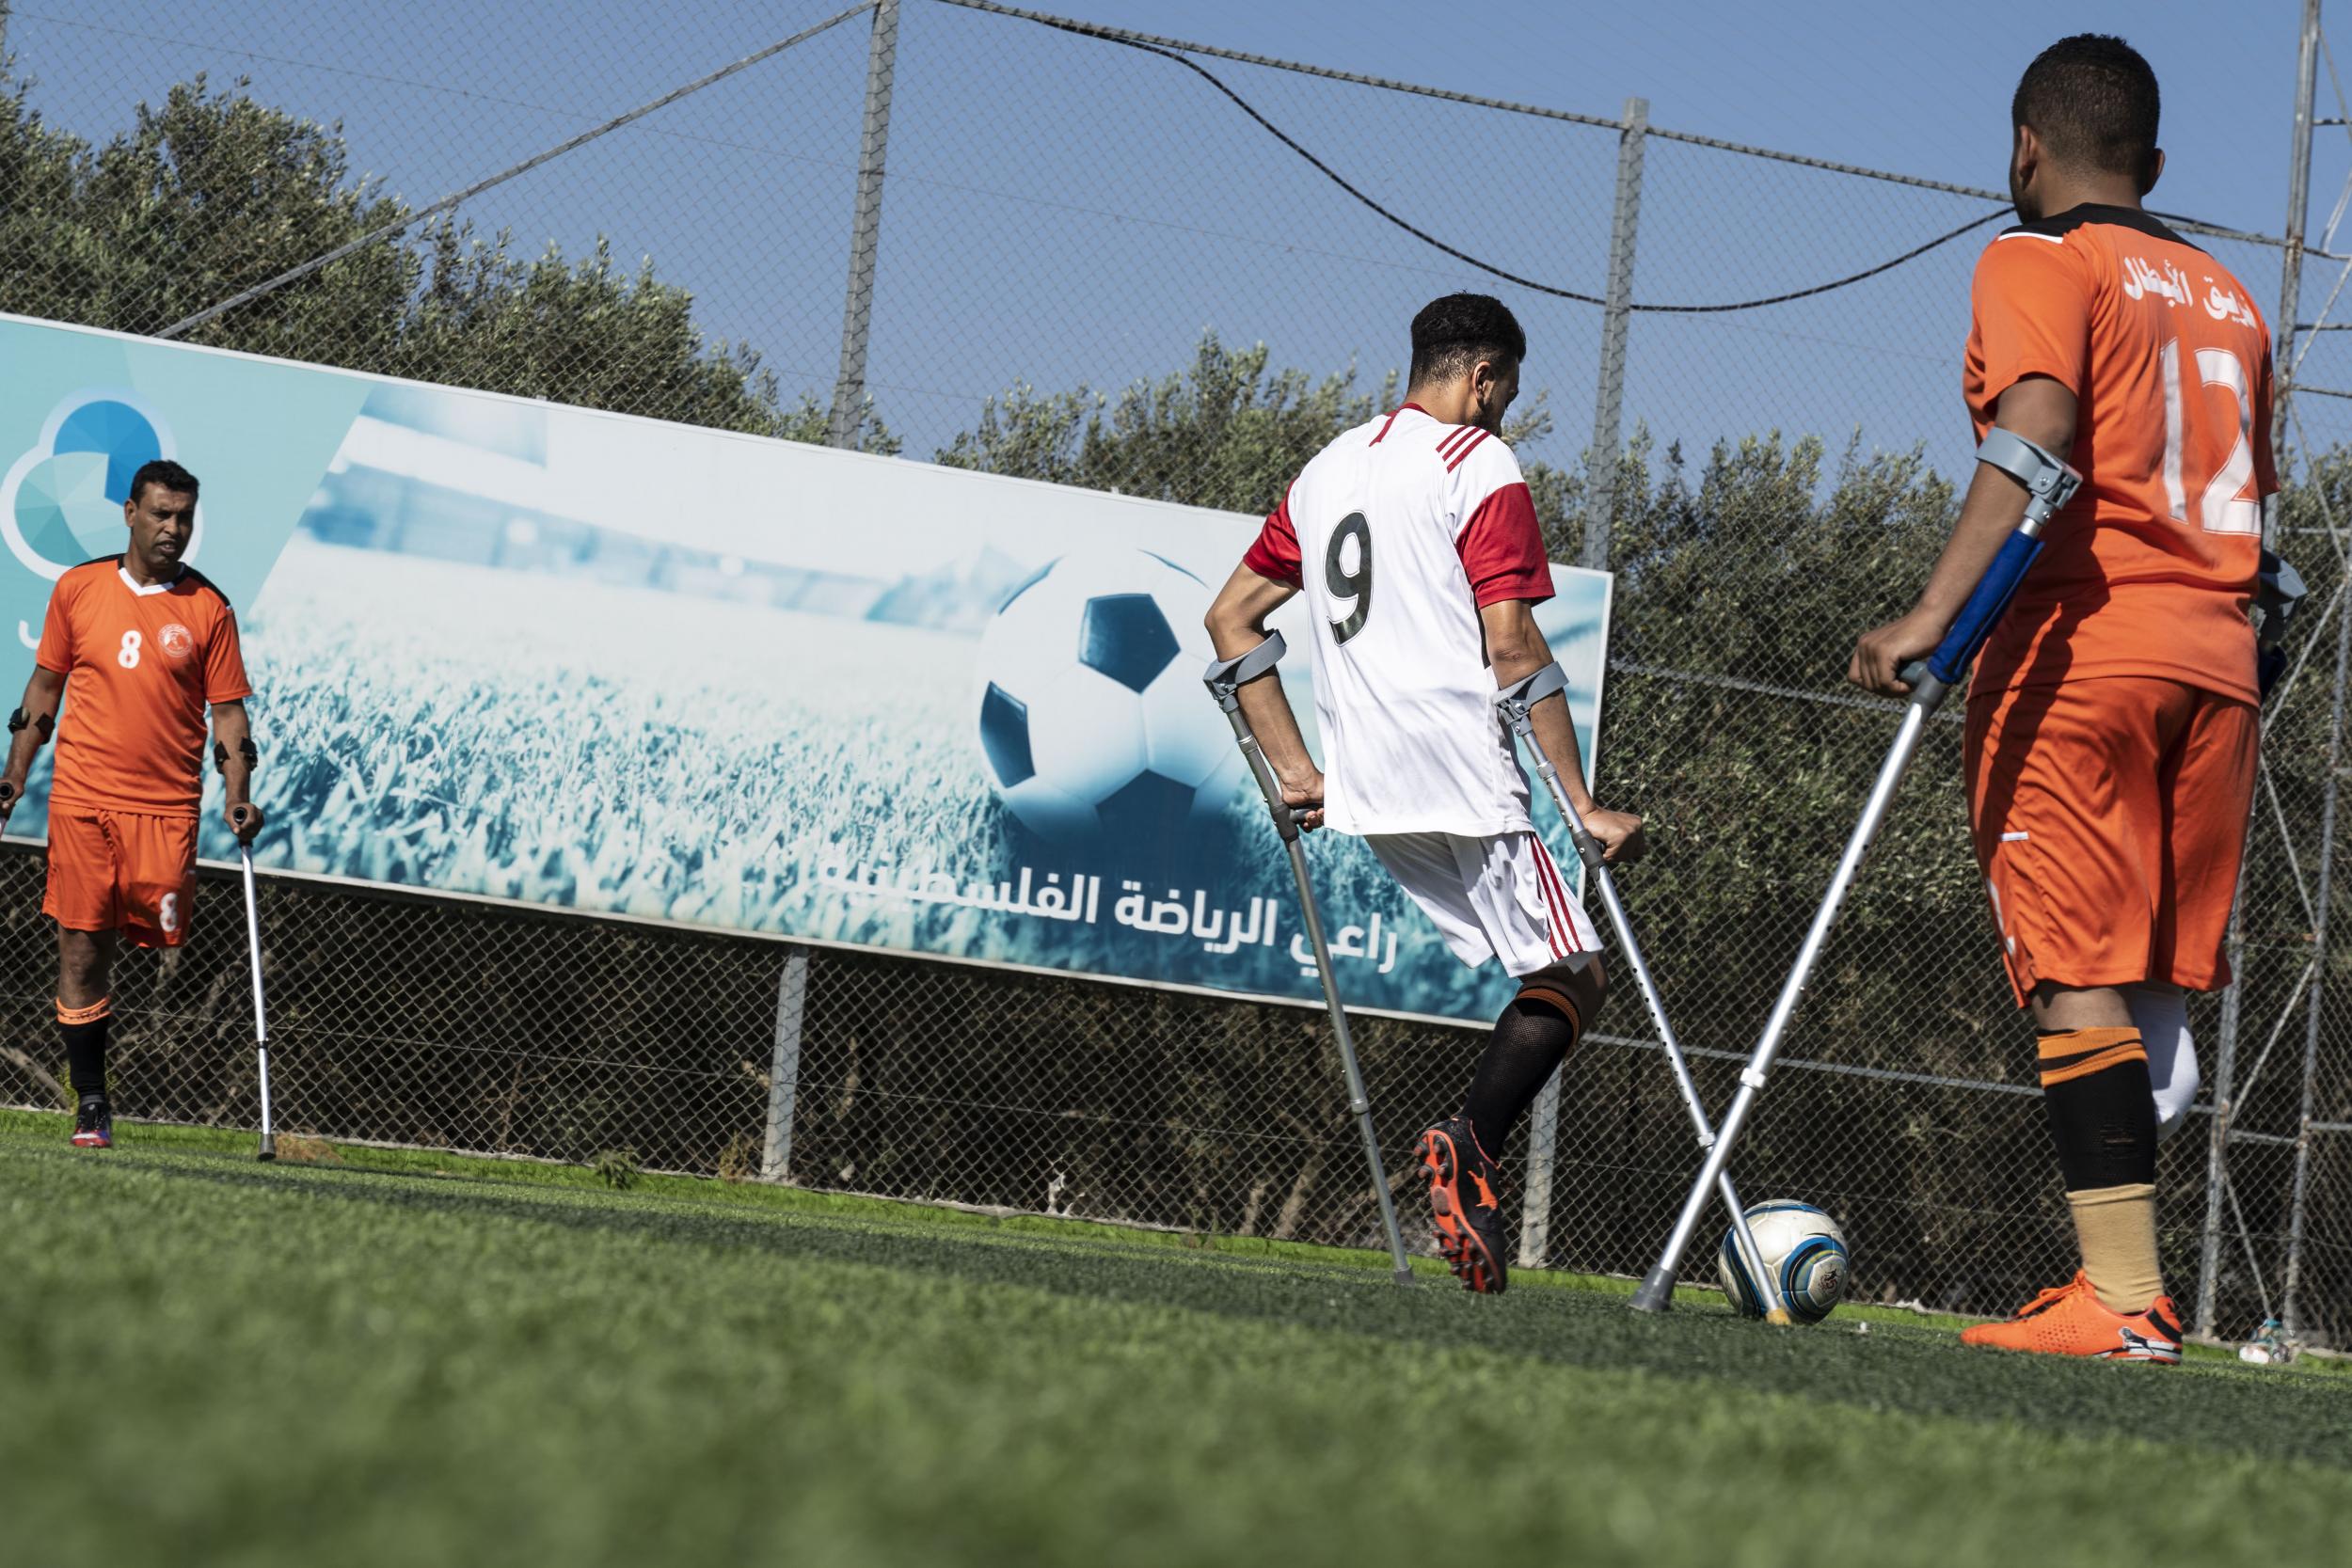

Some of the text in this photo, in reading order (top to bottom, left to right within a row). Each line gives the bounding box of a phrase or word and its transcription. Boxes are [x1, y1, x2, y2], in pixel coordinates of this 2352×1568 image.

[2202, 275, 2257, 329] فريق
[2160, 337, 2262, 537] 12
[1324, 509, 1375, 647] 9
[118, 629, 141, 669] 8
[159, 892, 178, 932] 8
[817, 849, 1397, 977] راعي الرياضة الفلسطينية
